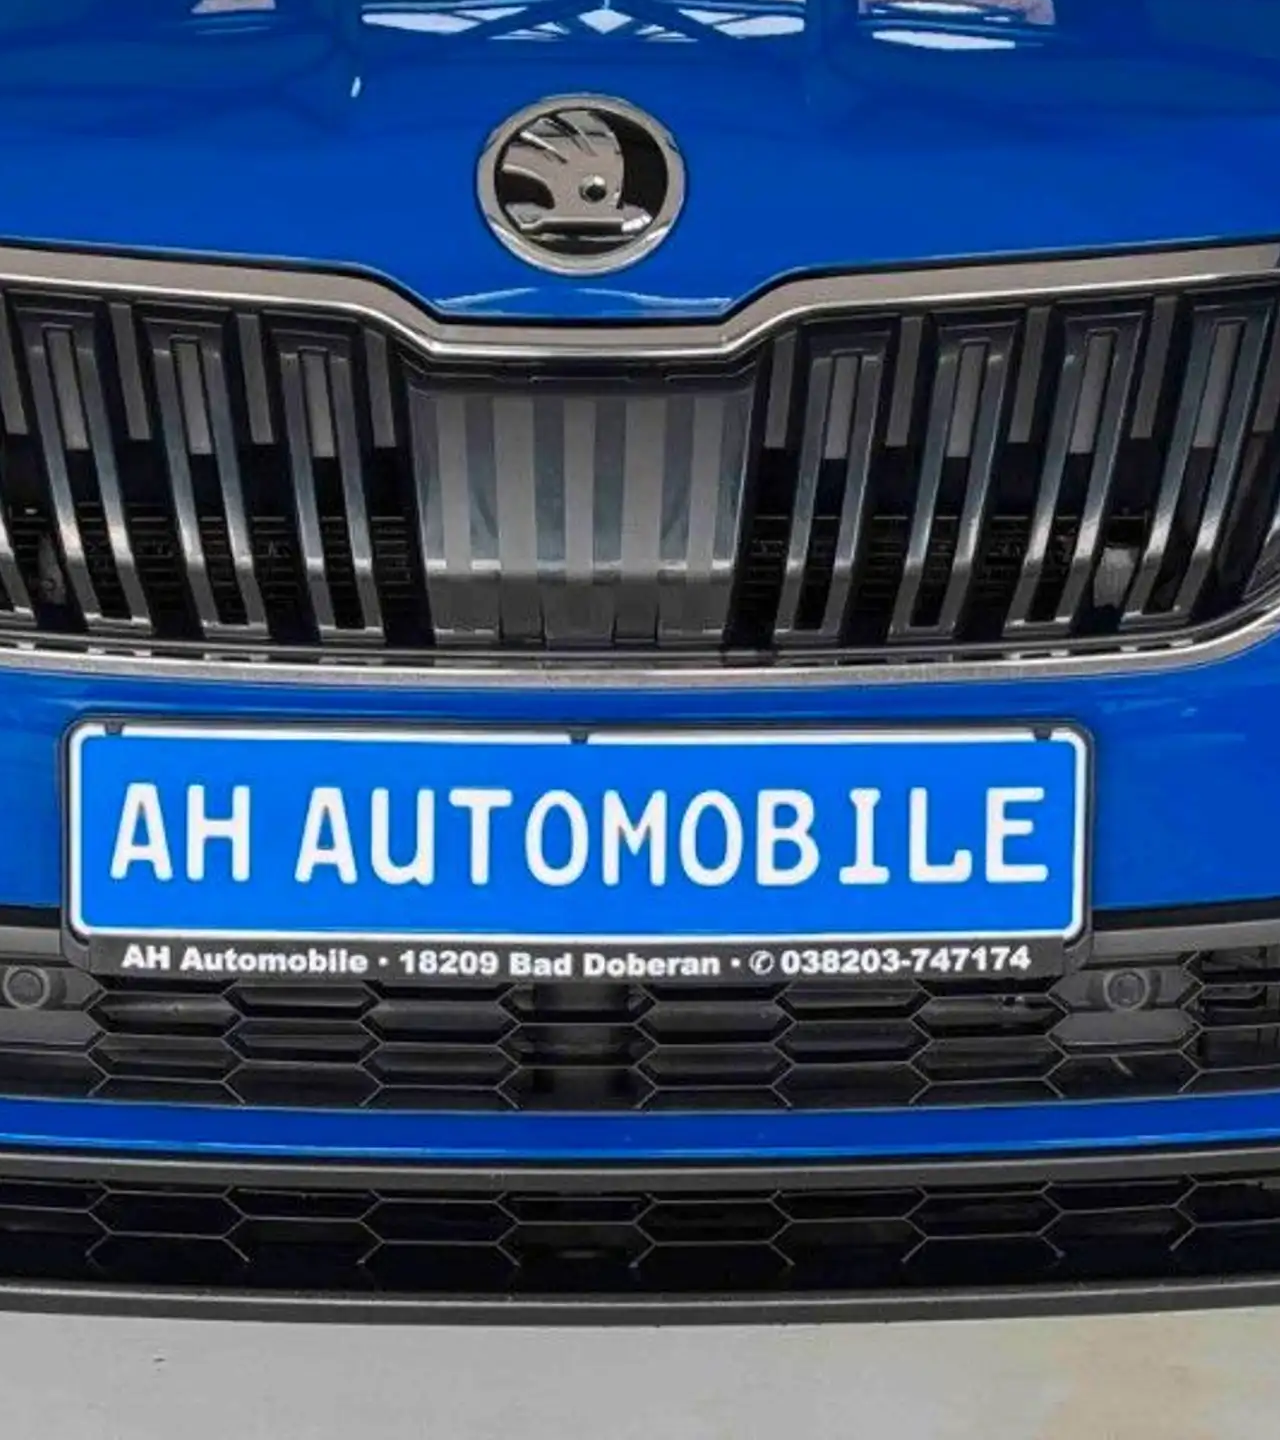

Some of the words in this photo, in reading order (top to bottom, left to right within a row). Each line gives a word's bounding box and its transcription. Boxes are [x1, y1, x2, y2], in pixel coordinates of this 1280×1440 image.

[109, 782, 250, 881] AH
[294, 786, 1047, 886] AUTOMOBILE
[121, 943, 170, 970] AH
[179, 945, 368, 973] Automobile
[399, 949, 498, 975] 18209
[509, 951, 572, 977] Bad
[584, 951, 720, 977] Doberan
[781, 945, 1031, 974] 038203-747174
